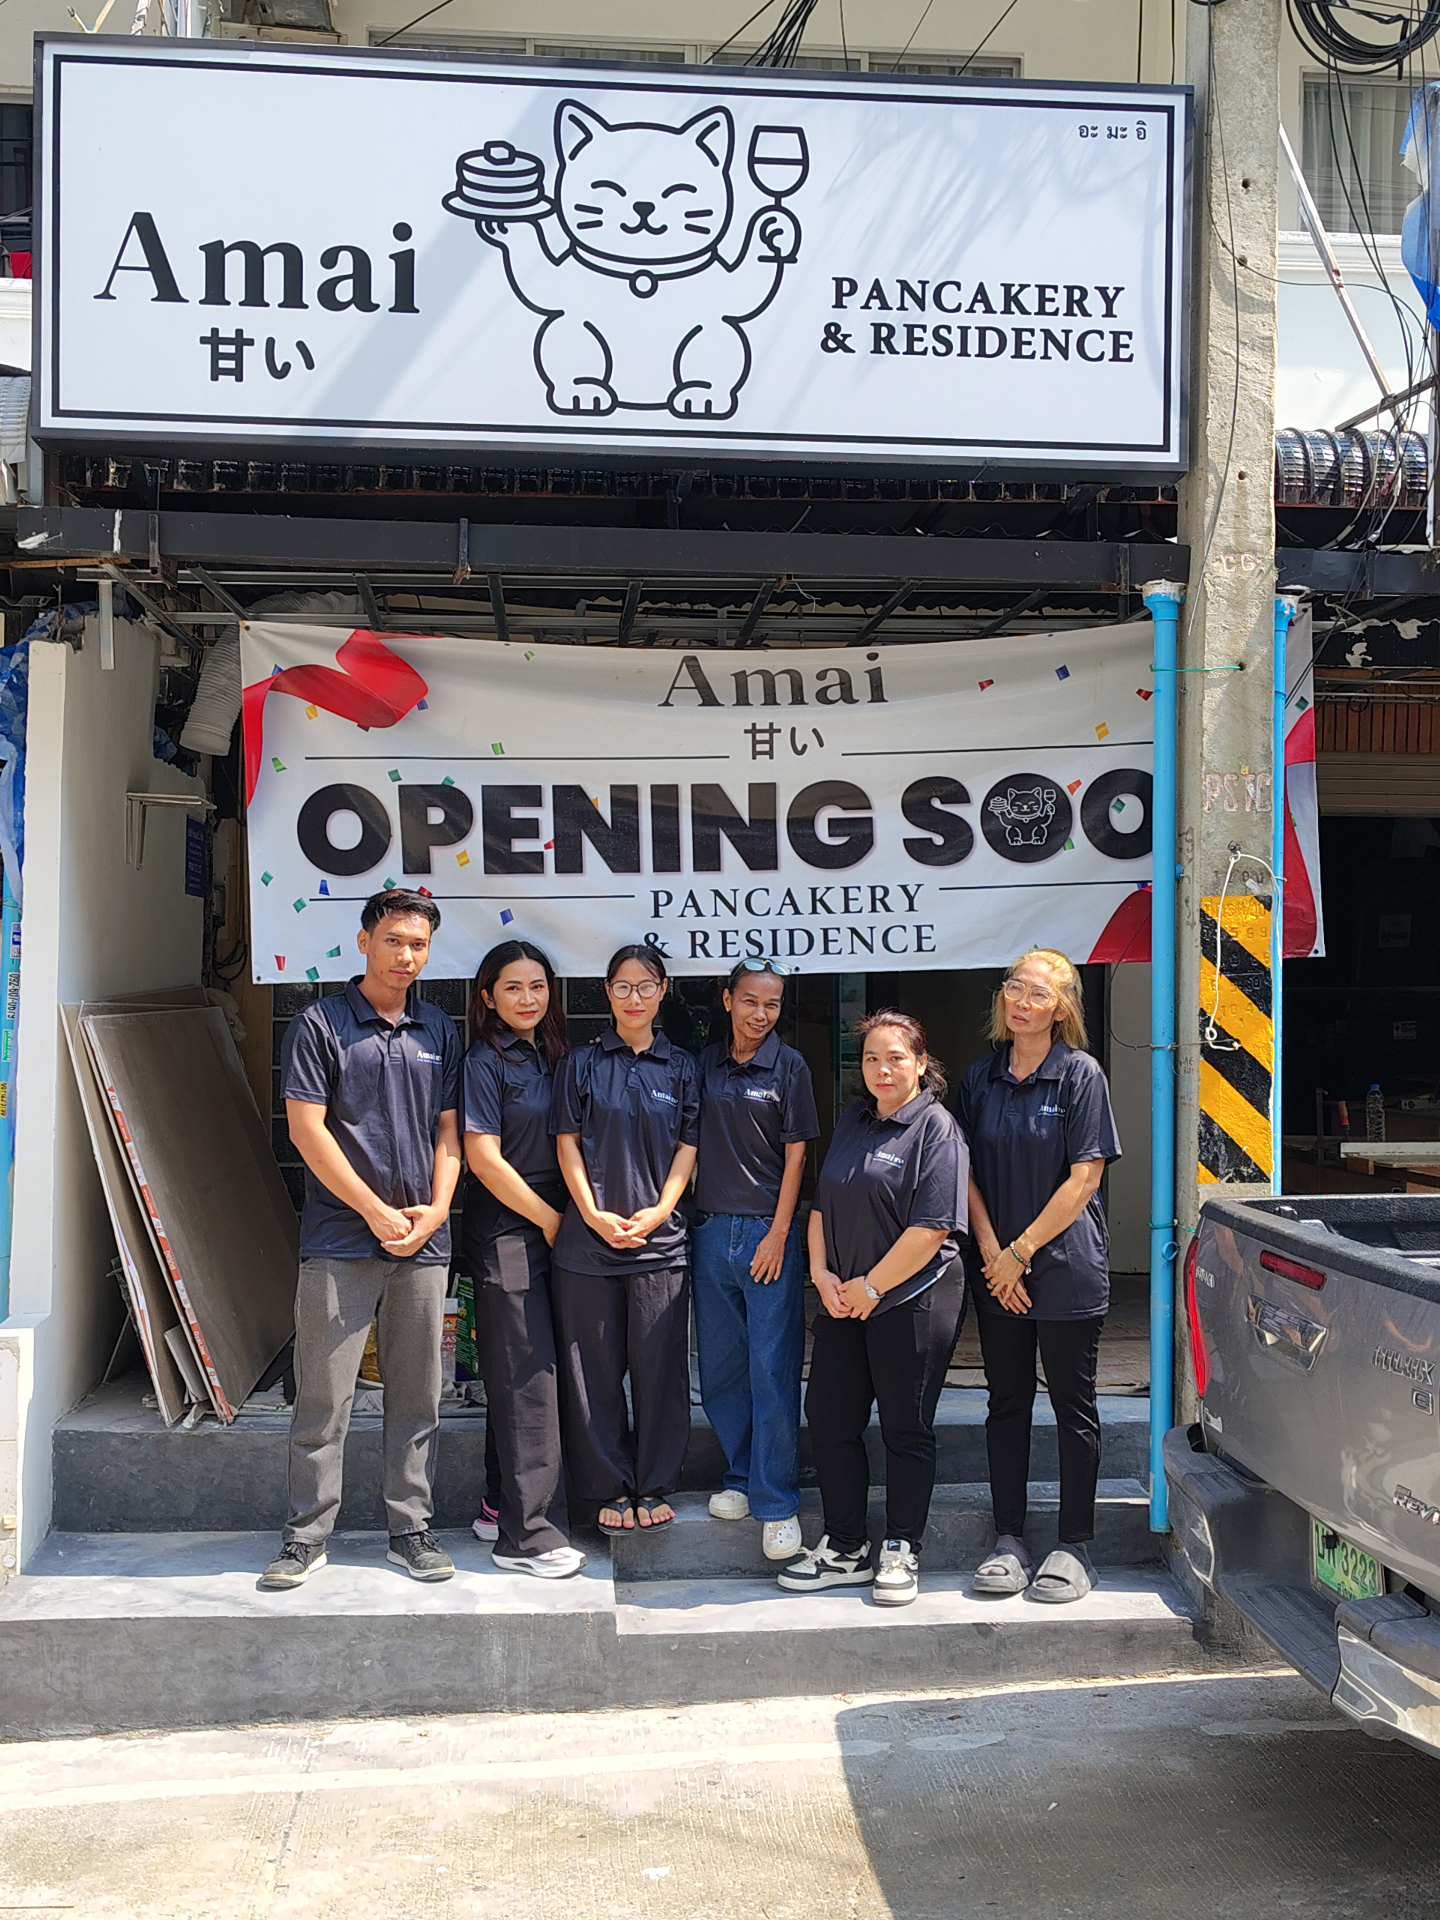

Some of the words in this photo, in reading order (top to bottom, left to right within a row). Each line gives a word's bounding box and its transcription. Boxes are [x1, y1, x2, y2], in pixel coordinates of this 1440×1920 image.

[93, 211, 420, 314] Amai
[831, 276, 1125, 319] PANCAKERY
[199, 327, 315, 383] 甘い
[820, 321, 856, 354] &
[869, 322, 1134, 363] RESIDENCE
[657, 651, 889, 707] Amai
[743, 721, 825, 760] 甘い
[296, 778, 875, 876] OPENING
[901, 768, 1154, 867] SOO
[650, 883, 925, 919] PANCAKERY
[644, 931, 673, 959] &
[687, 924, 937, 959] RESIDENCE
[1340, 1541, 1377, 1596] 3223
